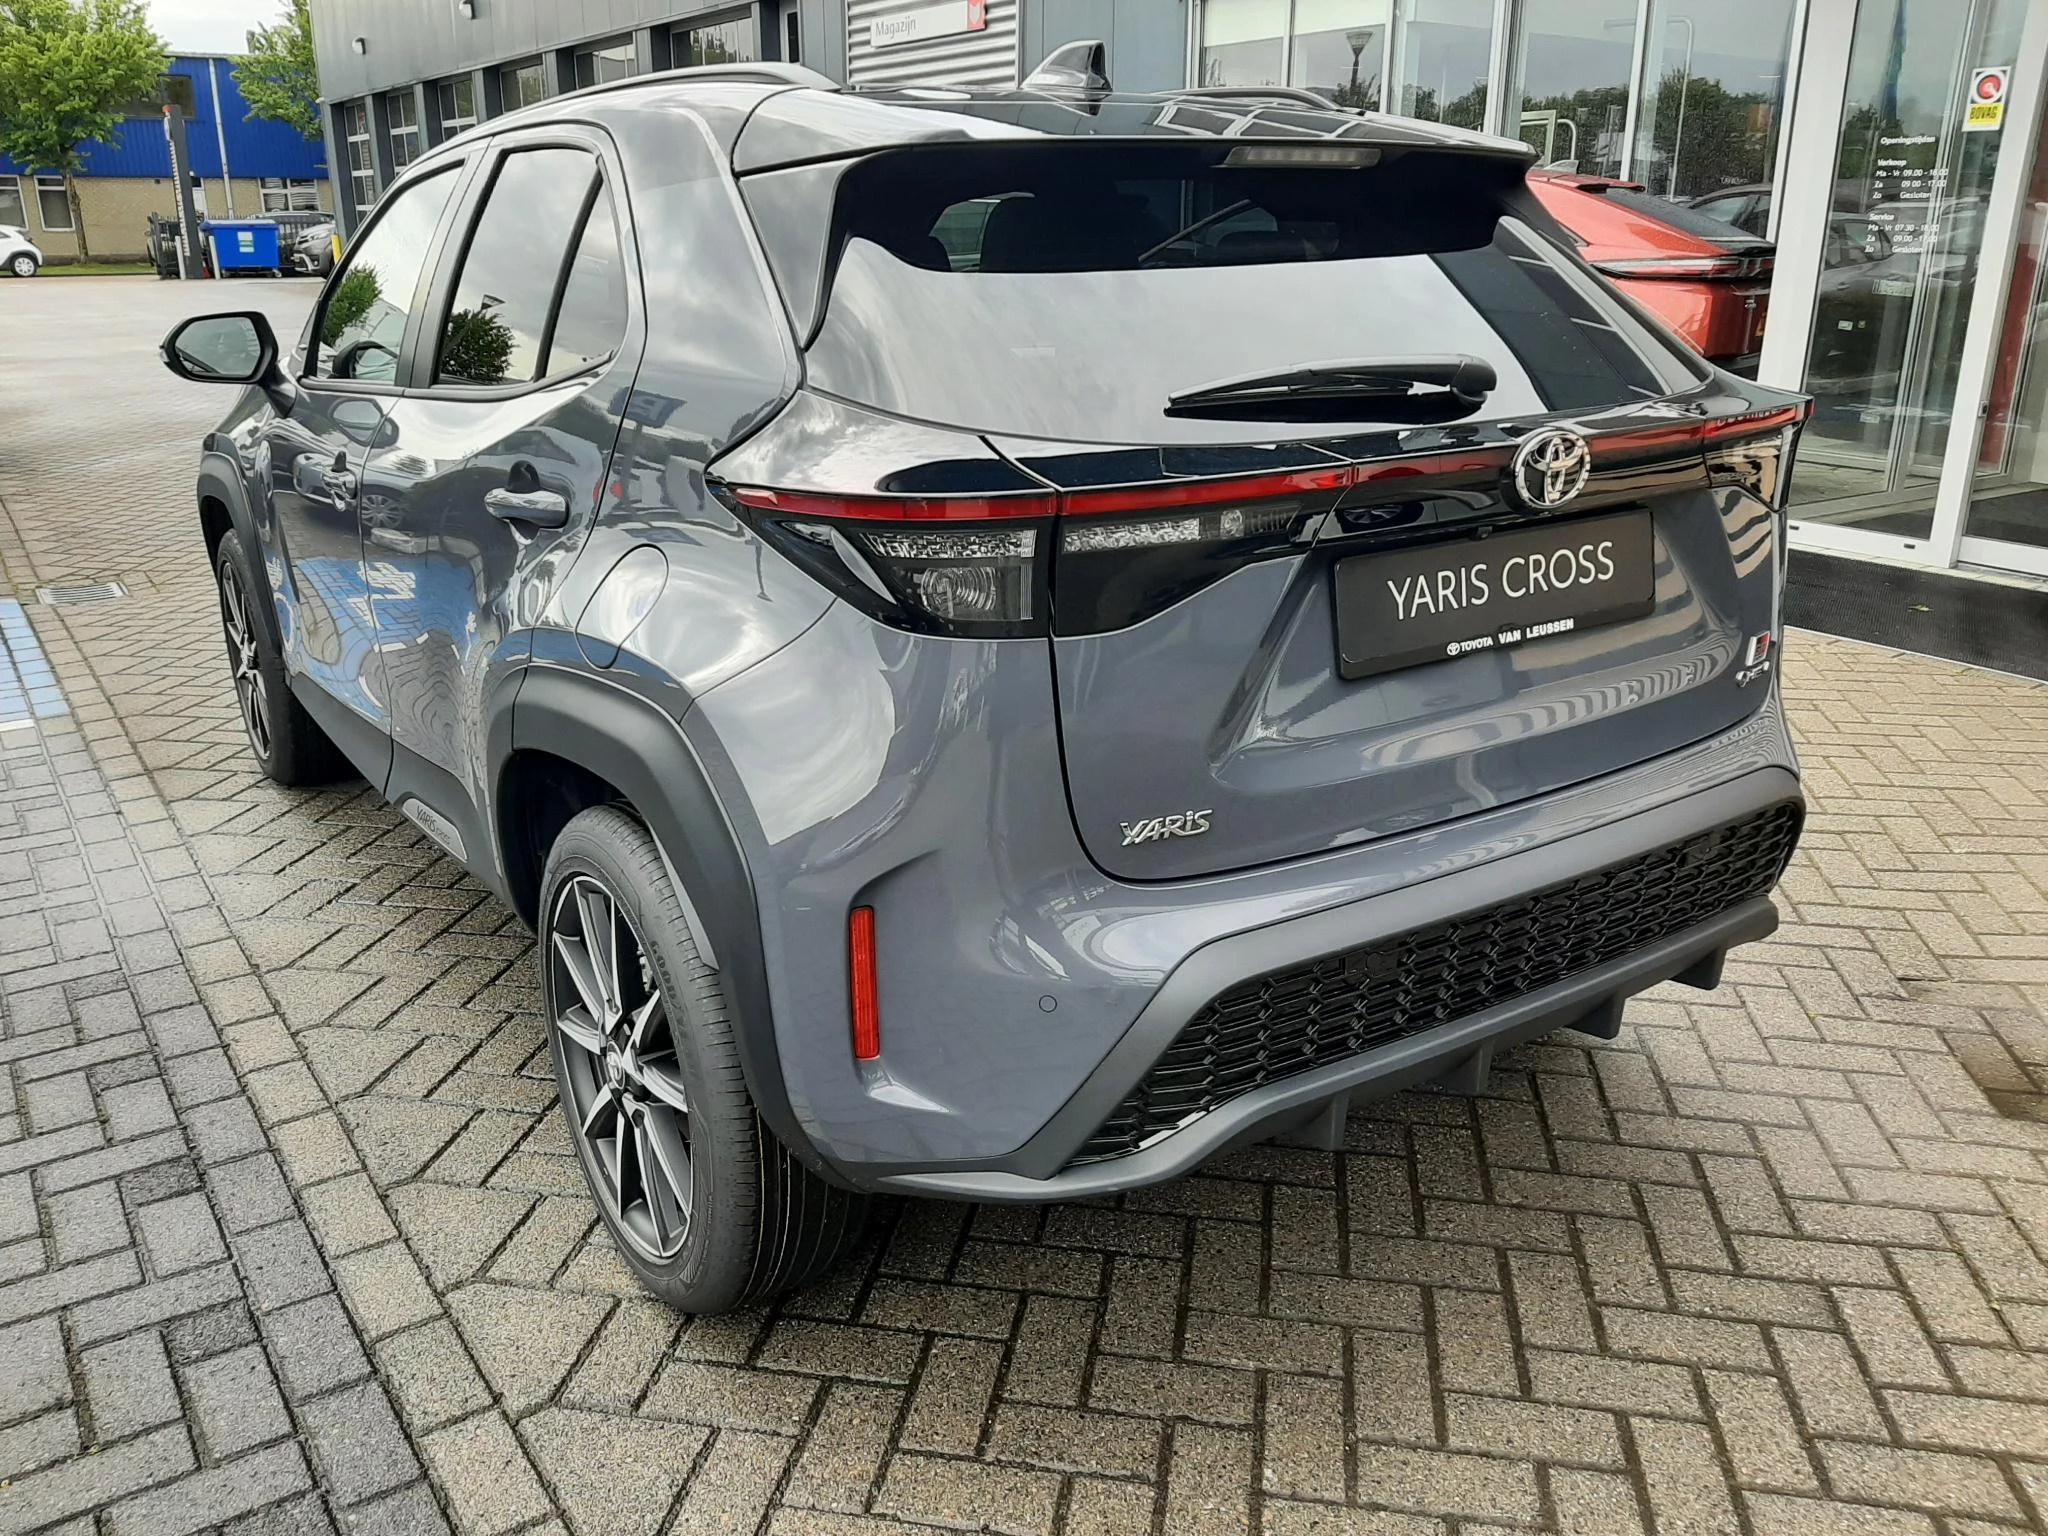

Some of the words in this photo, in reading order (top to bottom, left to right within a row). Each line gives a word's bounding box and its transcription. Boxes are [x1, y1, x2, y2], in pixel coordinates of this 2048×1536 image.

[875, 16, 917, 39] Magazijn
[1970, 106, 1999, 120] BOVAG
[1880, 135, 1936, 146] Openingstijden
[1877, 158, 1908, 168] Verkoop
[1869, 212, 1895, 221] Service
[1386, 563, 1490, 621] YARIS
[1502, 541, 1615, 599] CROSS
[1460, 636, 1494, 652] TOYOTA
[1498, 629, 1522, 645] VAN
[1526, 618, 1575, 639] LEUSSEN
